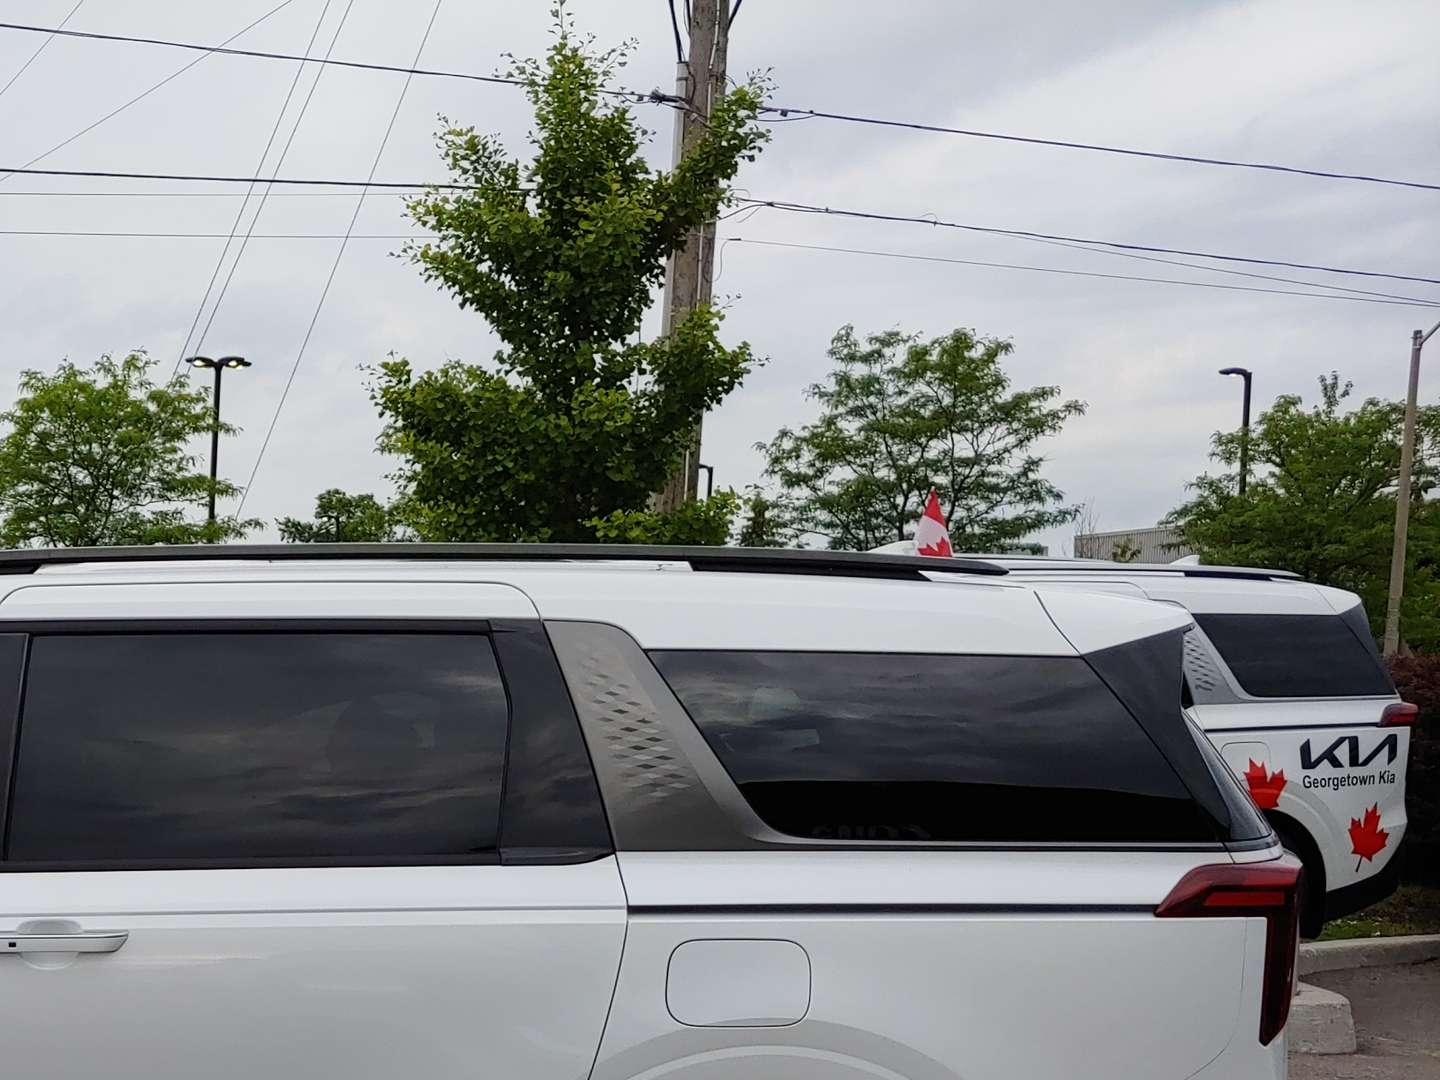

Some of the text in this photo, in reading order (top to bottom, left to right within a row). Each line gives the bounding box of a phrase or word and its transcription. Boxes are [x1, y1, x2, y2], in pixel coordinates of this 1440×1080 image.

[1299, 733, 1398, 770] KIA
[1302, 769, 1396, 791] Georgetown Kia
